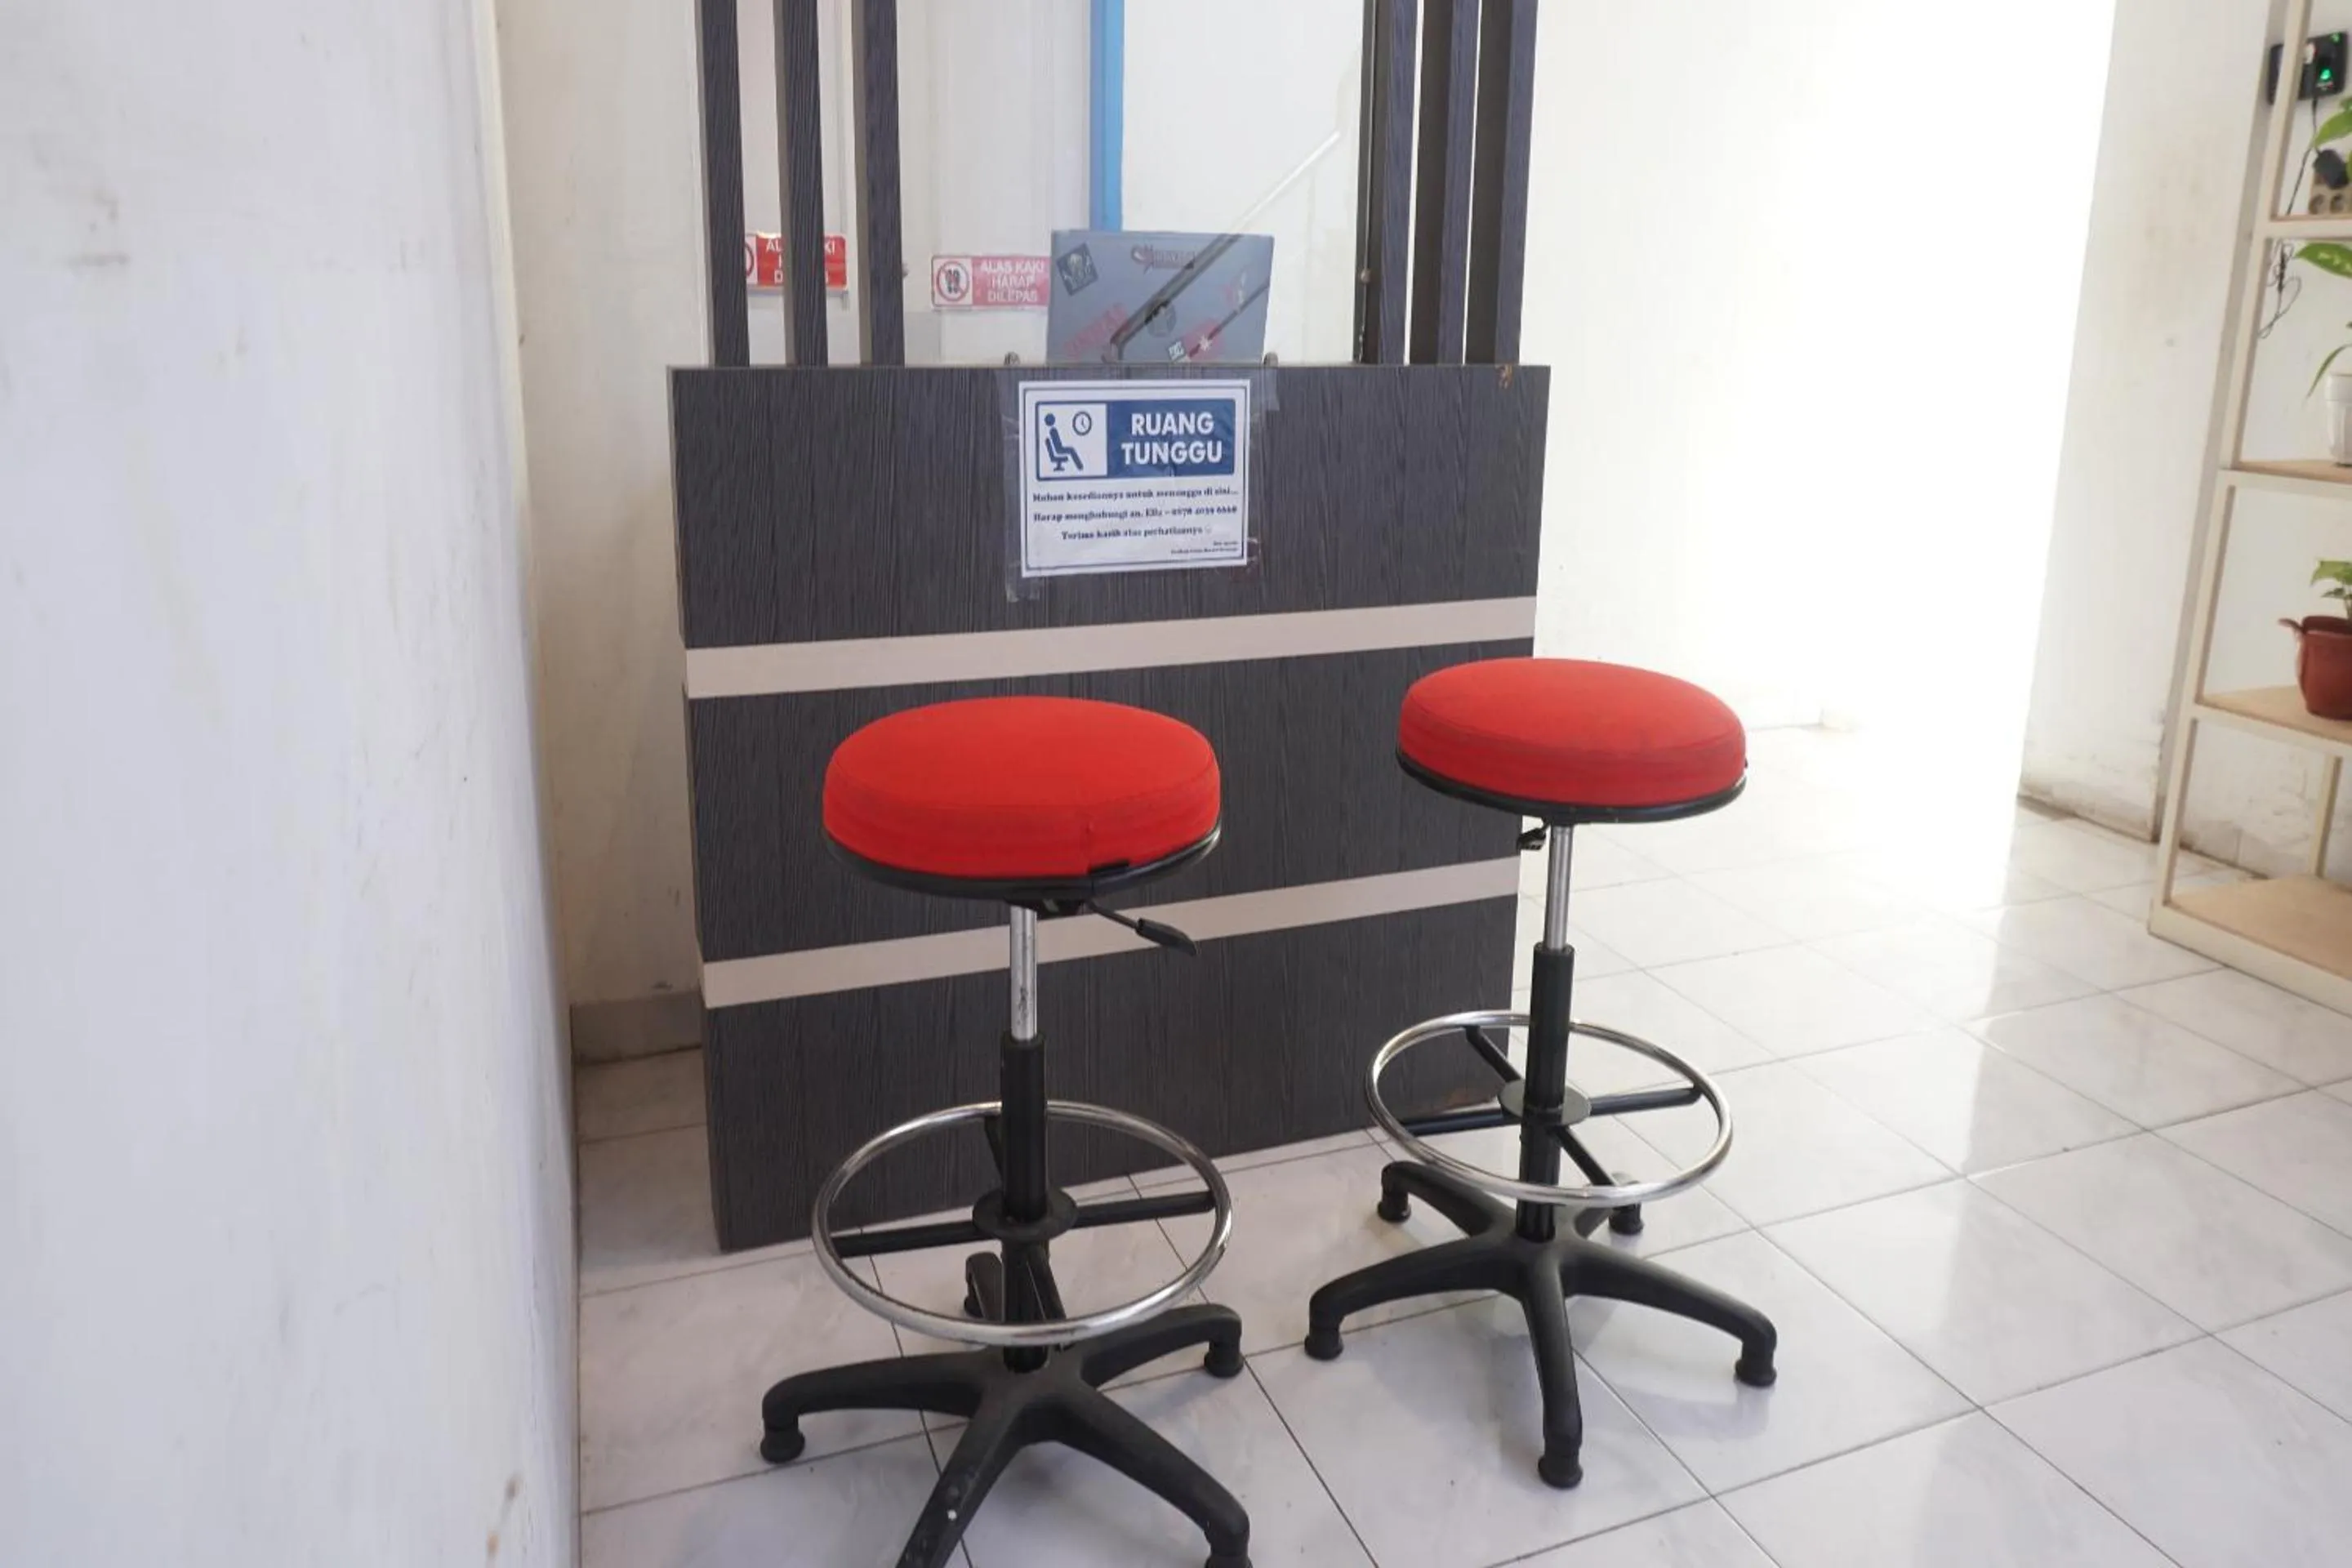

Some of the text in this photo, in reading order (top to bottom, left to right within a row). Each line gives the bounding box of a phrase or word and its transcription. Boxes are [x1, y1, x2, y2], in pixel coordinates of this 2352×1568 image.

[980, 260, 1013, 274] ALAS
[1131, 412, 1215, 436] RUANG
[1120, 440, 1223, 466] TUNGGU
[1097, 528, 1122, 539] kasih
